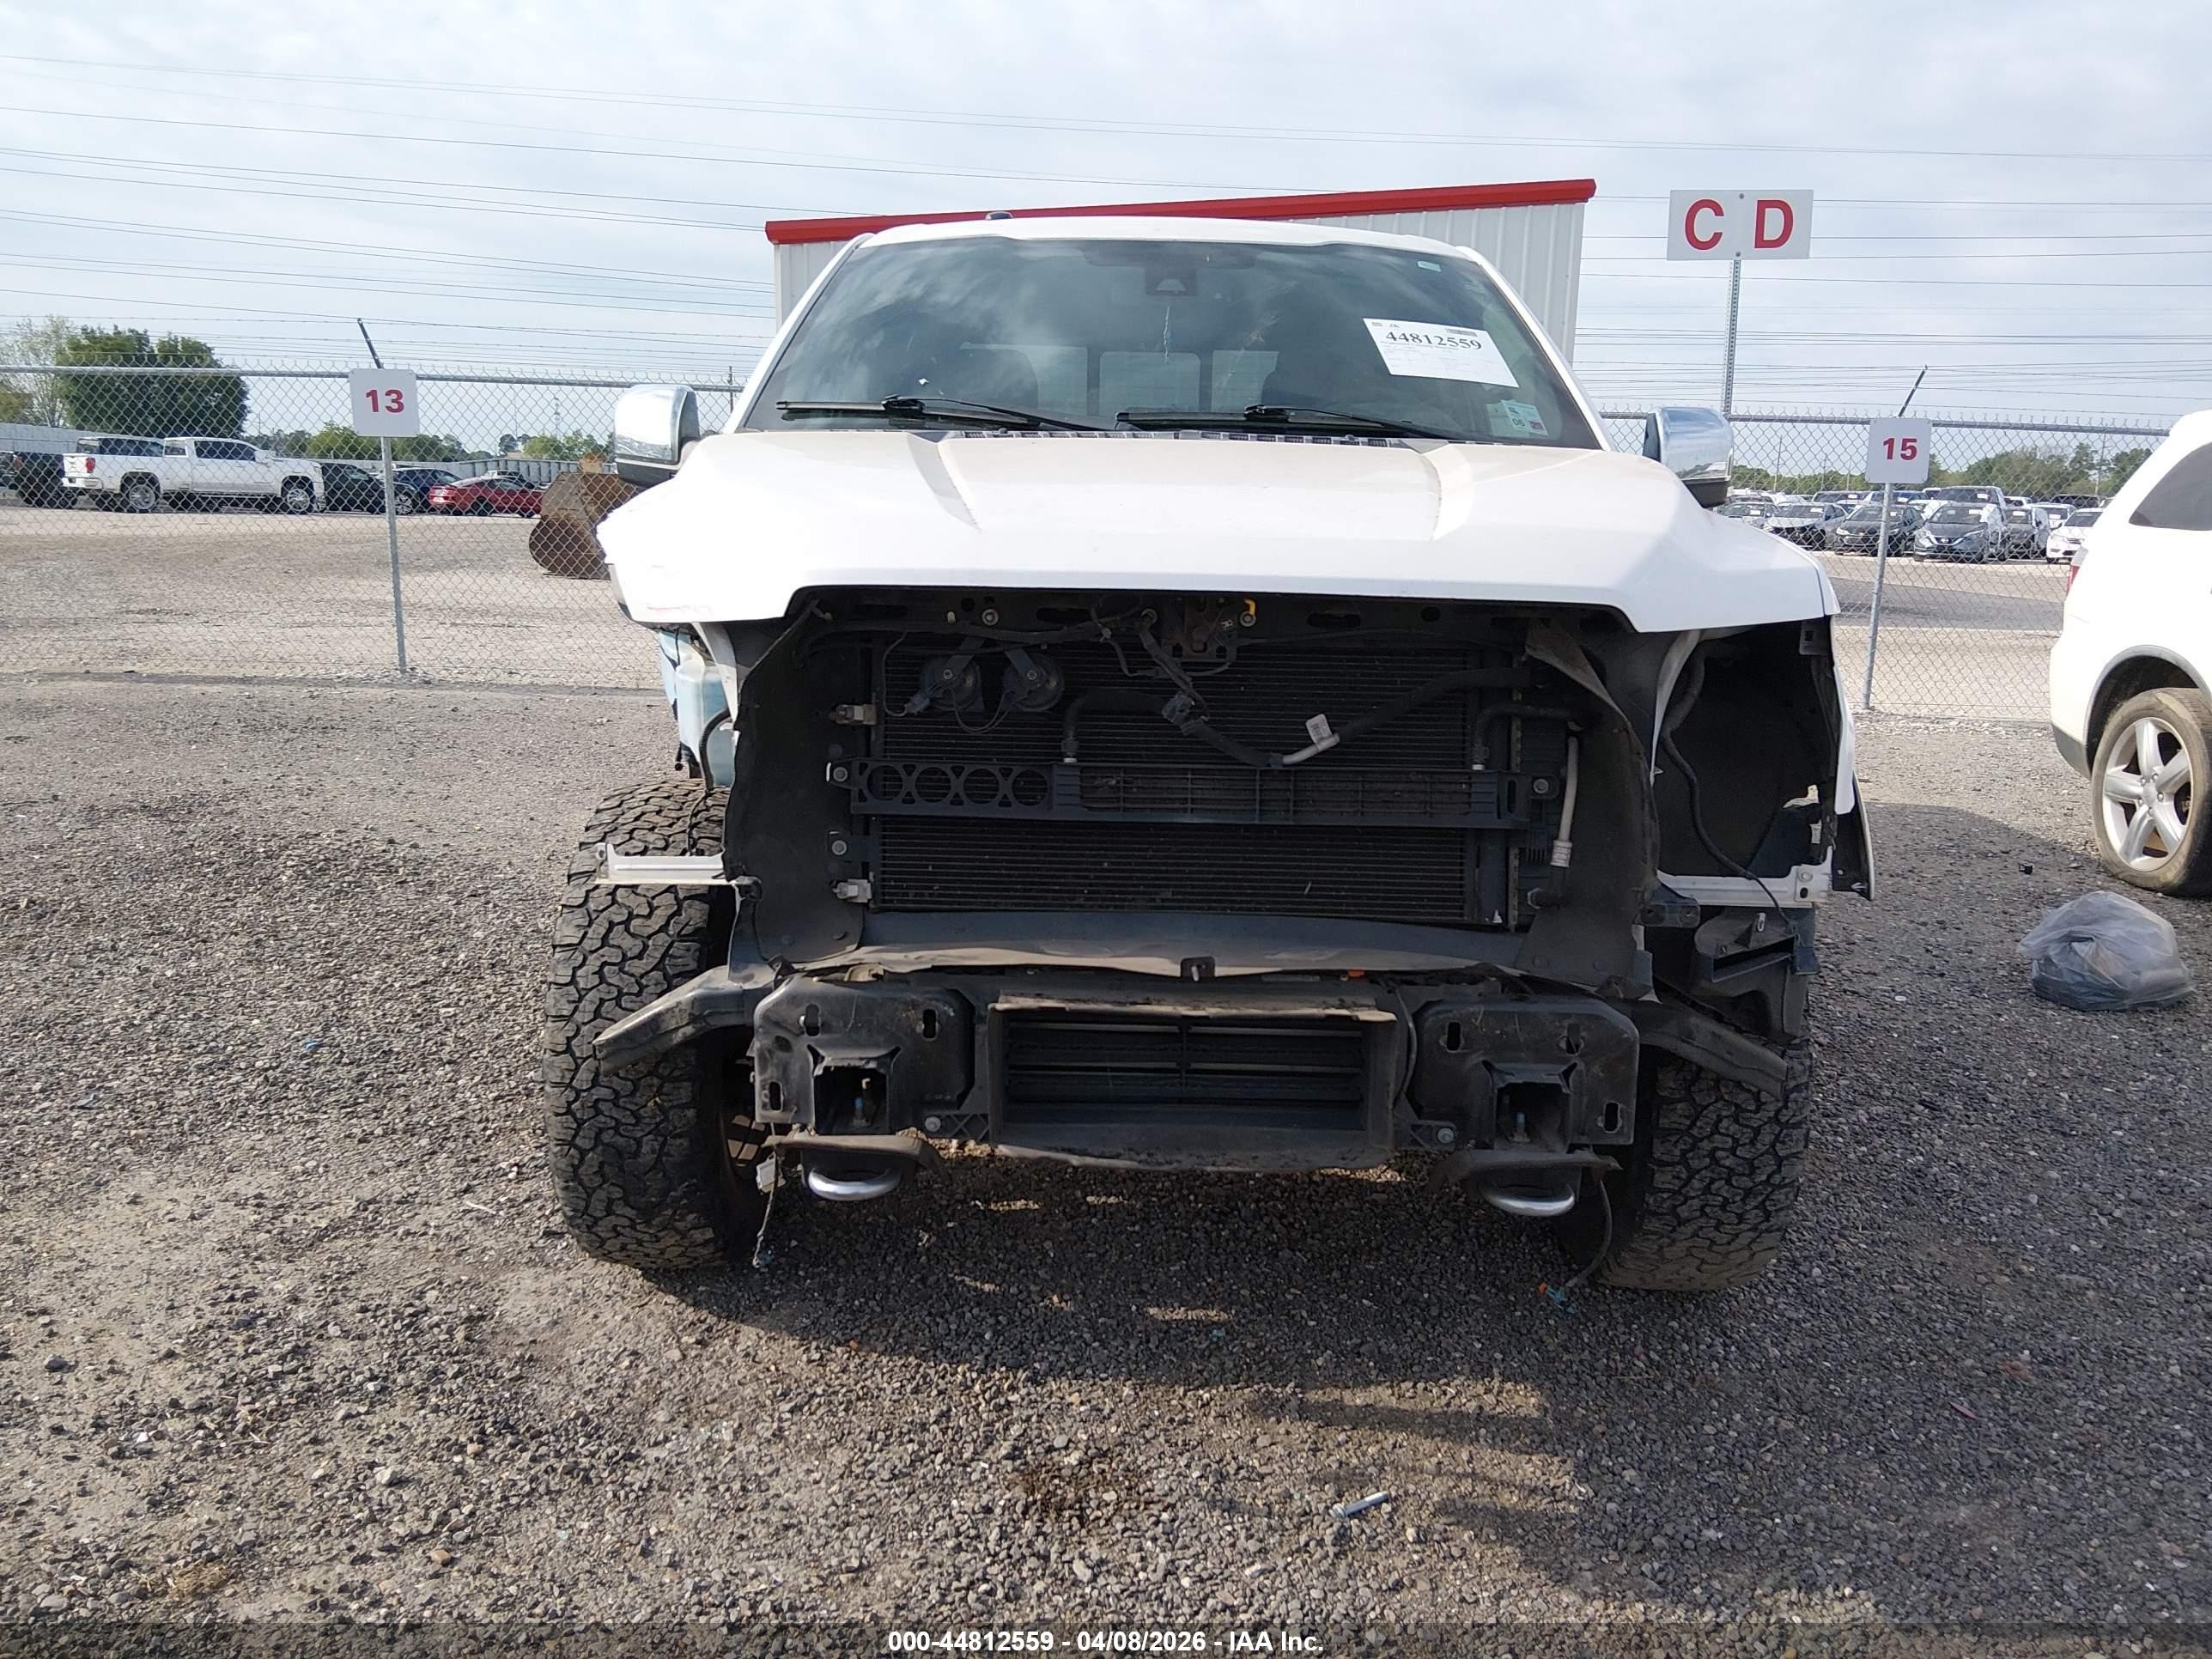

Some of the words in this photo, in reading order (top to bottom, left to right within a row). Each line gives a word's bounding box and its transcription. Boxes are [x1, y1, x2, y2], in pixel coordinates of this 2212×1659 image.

[1685, 199, 1724, 251] C
[1754, 199, 1793, 248] D
[1385, 331, 1482, 349] 44812559
[366, 389, 404, 413] 13
[1883, 438, 1917, 461] 15
